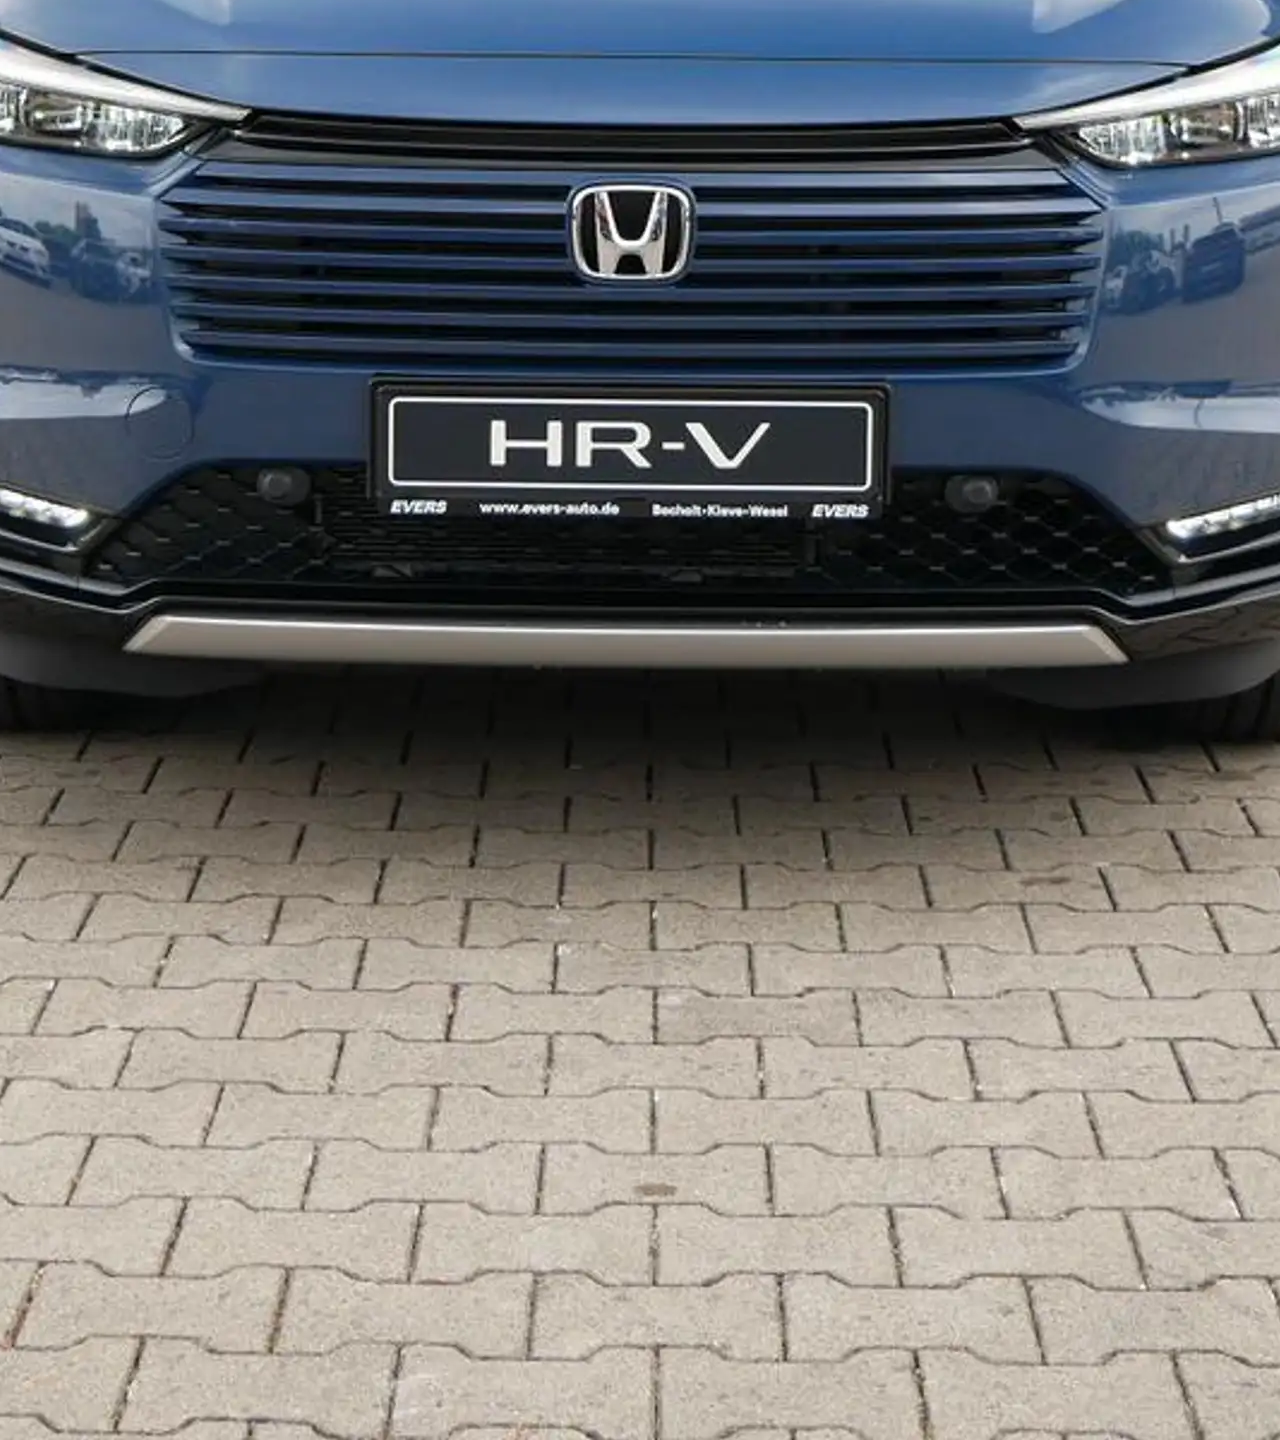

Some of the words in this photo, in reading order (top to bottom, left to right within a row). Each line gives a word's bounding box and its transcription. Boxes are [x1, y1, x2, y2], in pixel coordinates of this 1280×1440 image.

[489, 419, 771, 469] HR-V
[390, 499, 448, 515] EVERS
[479, 502, 620, 516] www.evers-auto.de
[812, 504, 869, 519] EVERS
